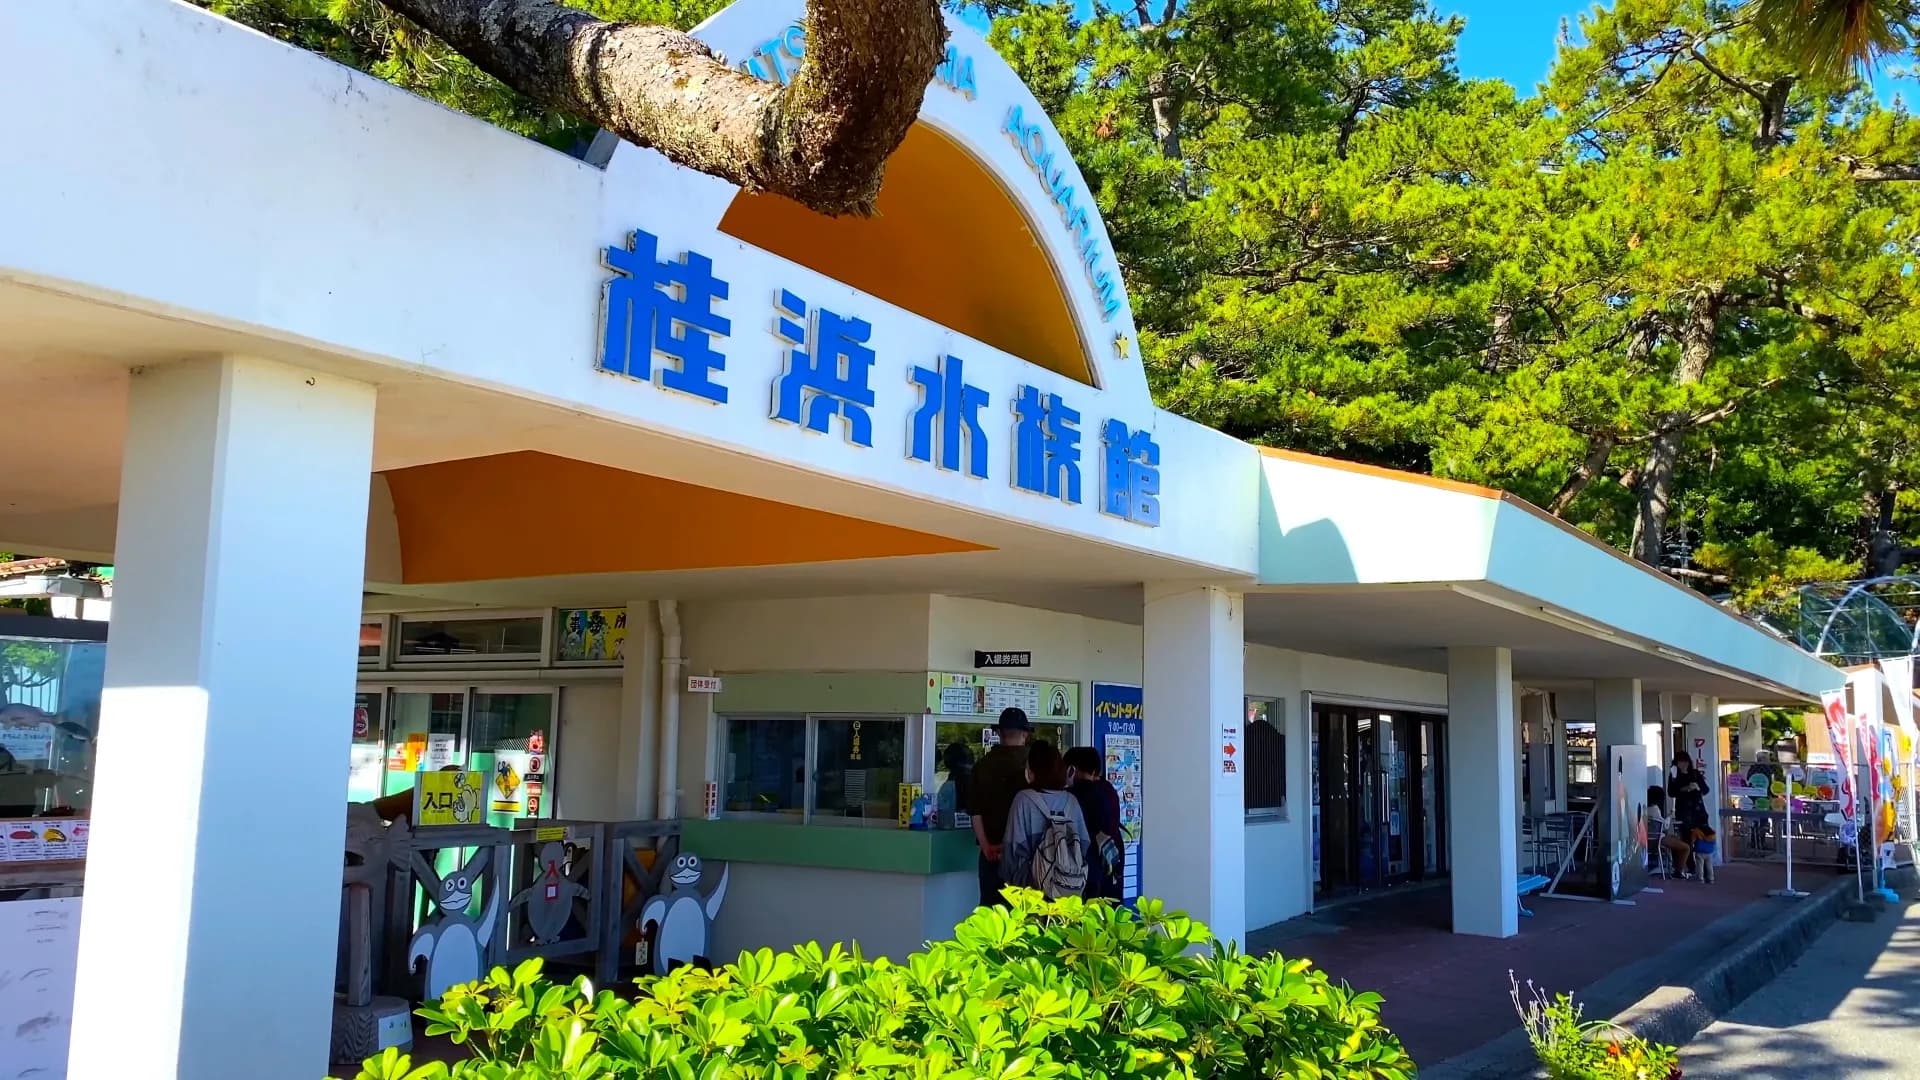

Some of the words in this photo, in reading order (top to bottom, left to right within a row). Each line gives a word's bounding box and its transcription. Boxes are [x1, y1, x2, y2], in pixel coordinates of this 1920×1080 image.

[1002, 104, 1120, 323] AQUARIUM
[594, 228, 1160, 527] 桂浜水族館
[985, 654, 1029, 665] 入場券売場
[690, 679, 717, 690] 団体受付
[423, 792, 453, 810] 入口
